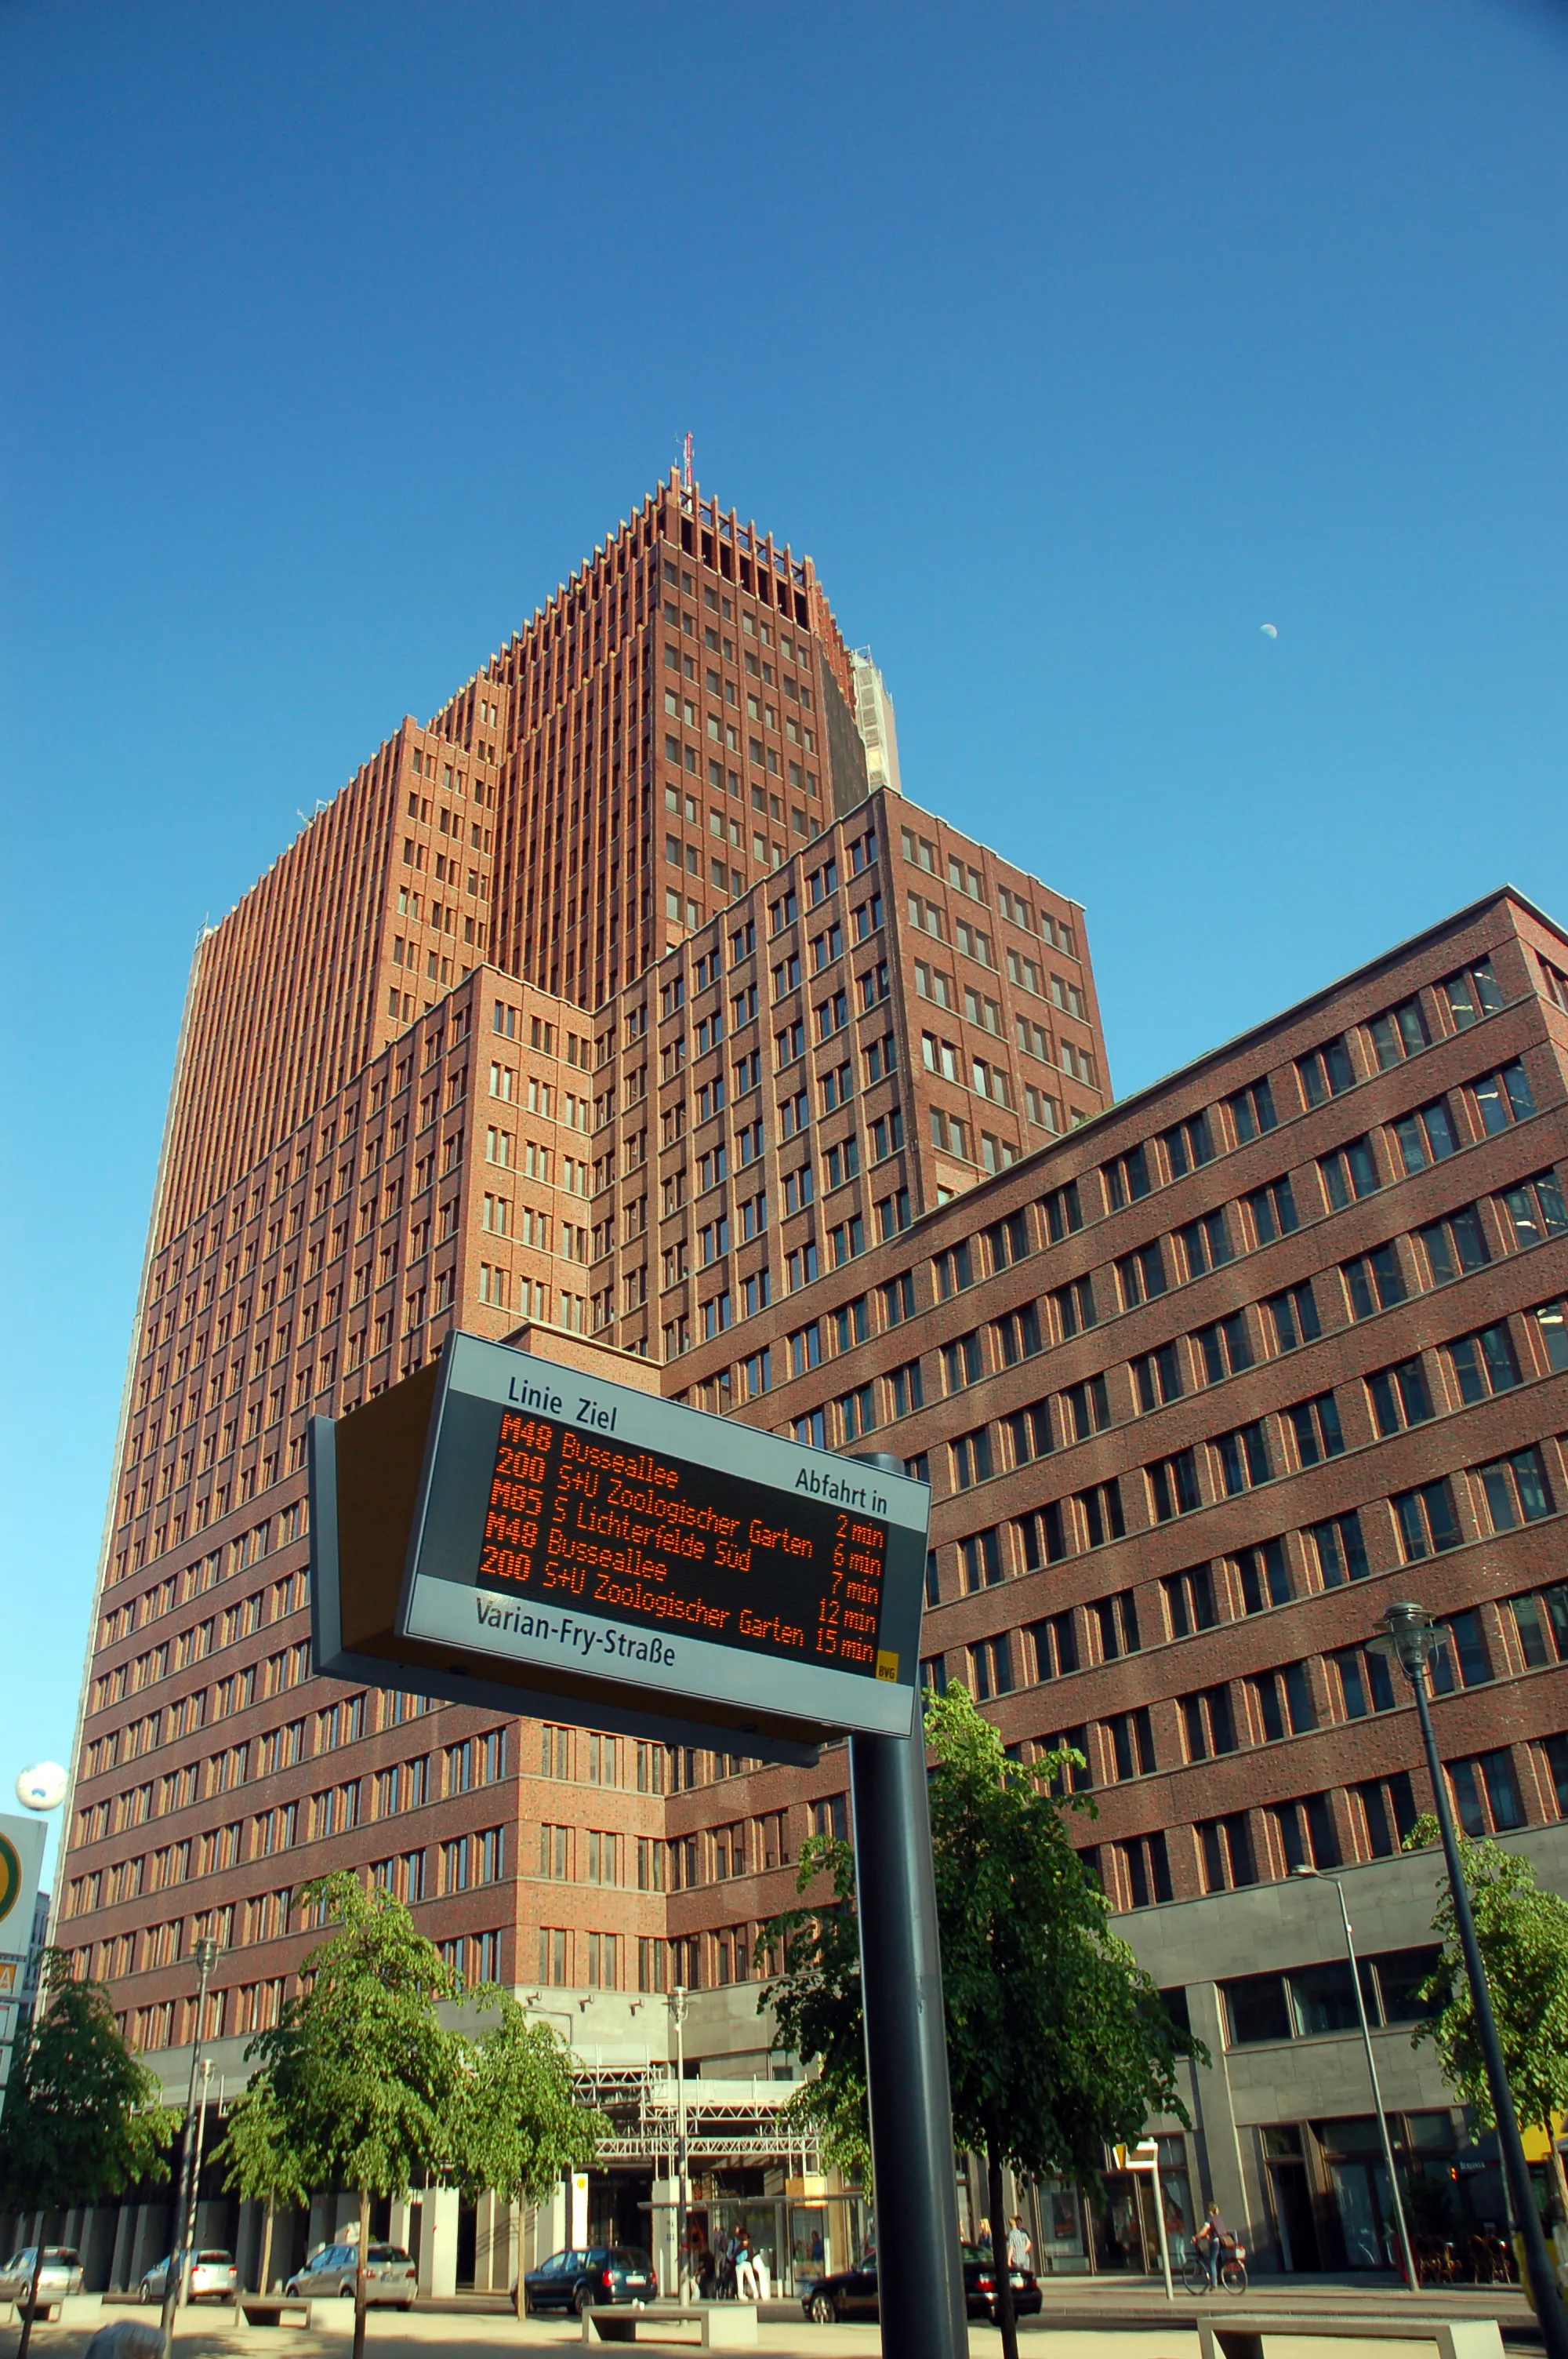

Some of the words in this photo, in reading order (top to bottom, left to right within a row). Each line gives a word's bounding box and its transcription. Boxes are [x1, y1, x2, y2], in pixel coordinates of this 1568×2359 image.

[500, 1413, 553, 1452] M48
[561, 1431, 679, 1489] Busseallee
[836, 1514, 848, 1538] 2
[851, 1522, 884, 1548] min
[509, 1376, 562, 1415] Linie
[576, 1398, 617, 1431] Ziel
[795, 1468, 866, 1508] Abfahrt
[872, 1490, 887, 1514] in
[485, 1511, 539, 1549] M48
[548, 1528, 666, 1581] Busseallee
[819, 1598, 840, 1625] 12
[844, 1608, 877, 1634] min
[490, 1478, 544, 1515] M85
[552, 1496, 568, 1522] S
[577, 1502, 706, 1559] Lichterfelde
[714, 1540, 751, 1571] Süd
[832, 1571, 844, 1594] 7
[846, 1579, 879, 1605] min
[495, 1446, 546, 1483] 200
[557, 1464, 599, 1497] S+U
[606, 1478, 740, 1536] Zoologischer
[749, 1518, 812, 1558] Garten
[833, 1543, 844, 1566] 6
[849, 1550, 881, 1576] min
[477, 1598, 675, 1666] Varian-Fry-Straße
[481, 1545, 532, 1581] 200
[543, 1561, 586, 1594] S+U
[593, 1572, 731, 1628] Zoologischer
[739, 1608, 804, 1646] Garten
[815, 1627, 838, 1653] 15
[840, 1637, 874, 1663] min
[879, 1665, 895, 1680] BVG
